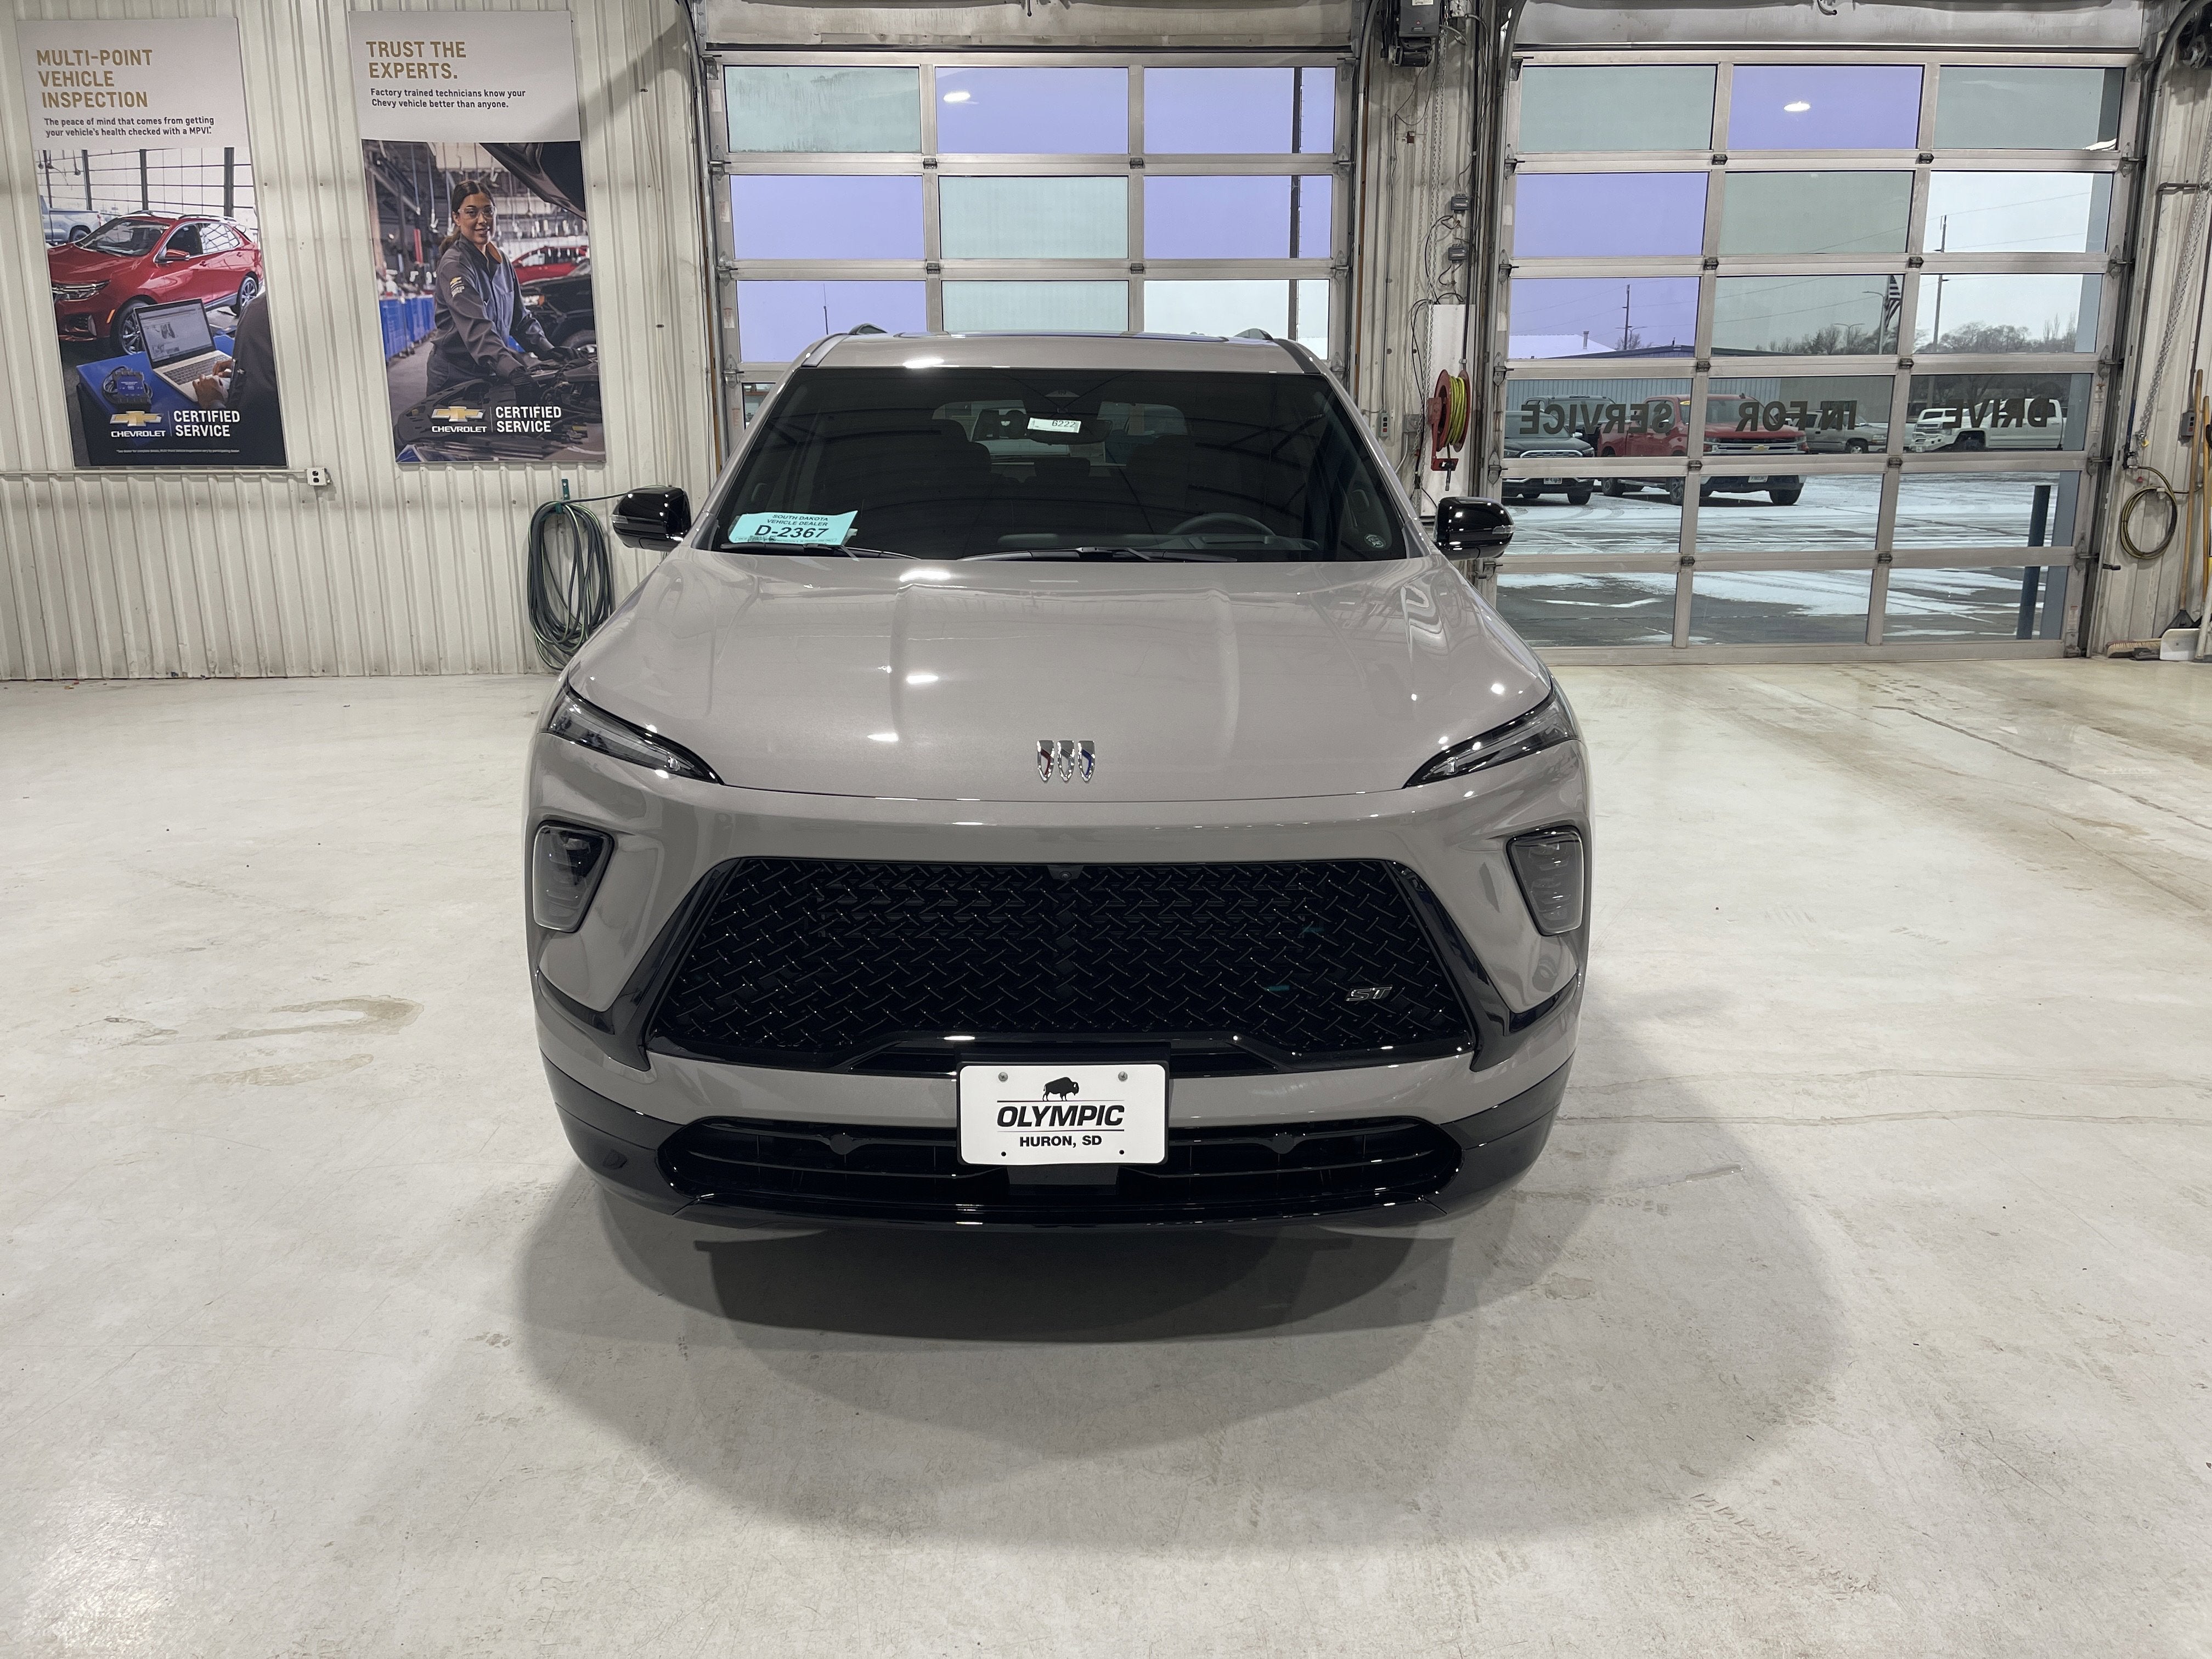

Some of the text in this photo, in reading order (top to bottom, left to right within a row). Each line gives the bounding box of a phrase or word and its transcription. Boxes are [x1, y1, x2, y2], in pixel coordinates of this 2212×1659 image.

[366, 41, 466, 58] TRUST THE
[36, 49, 153, 66] MULTI-POINT
[369, 63, 458, 79] EXPERTS.
[38, 71, 115, 87] VEHICLE
[370, 88, 402, 98] Factory
[42, 92, 148, 108] INSPECTION
[371, 99, 396, 108] Chevy
[398, 99, 427, 108] vehicle
[477, 101, 509, 109] anyone.
[61, 119, 84, 127] peace
[185, 116, 215, 126] getting
[46, 129, 64, 138] your
[65, 128, 99, 136] vehicle's
[128, 127, 161, 136] checked
[173, 410, 240, 423] CERTIFIED
[495, 406, 561, 419] CERTIFIED
[175, 425, 230, 437] SERVICE
[496, 420, 551, 432] SERVICE
[754, 524, 829, 538] D-2367
[1346, 986, 1392, 1001] ST
[997, 1105, 1125, 1127] OLYMPIC
[1019, 1135, 1102, 1148] HURON, SD
